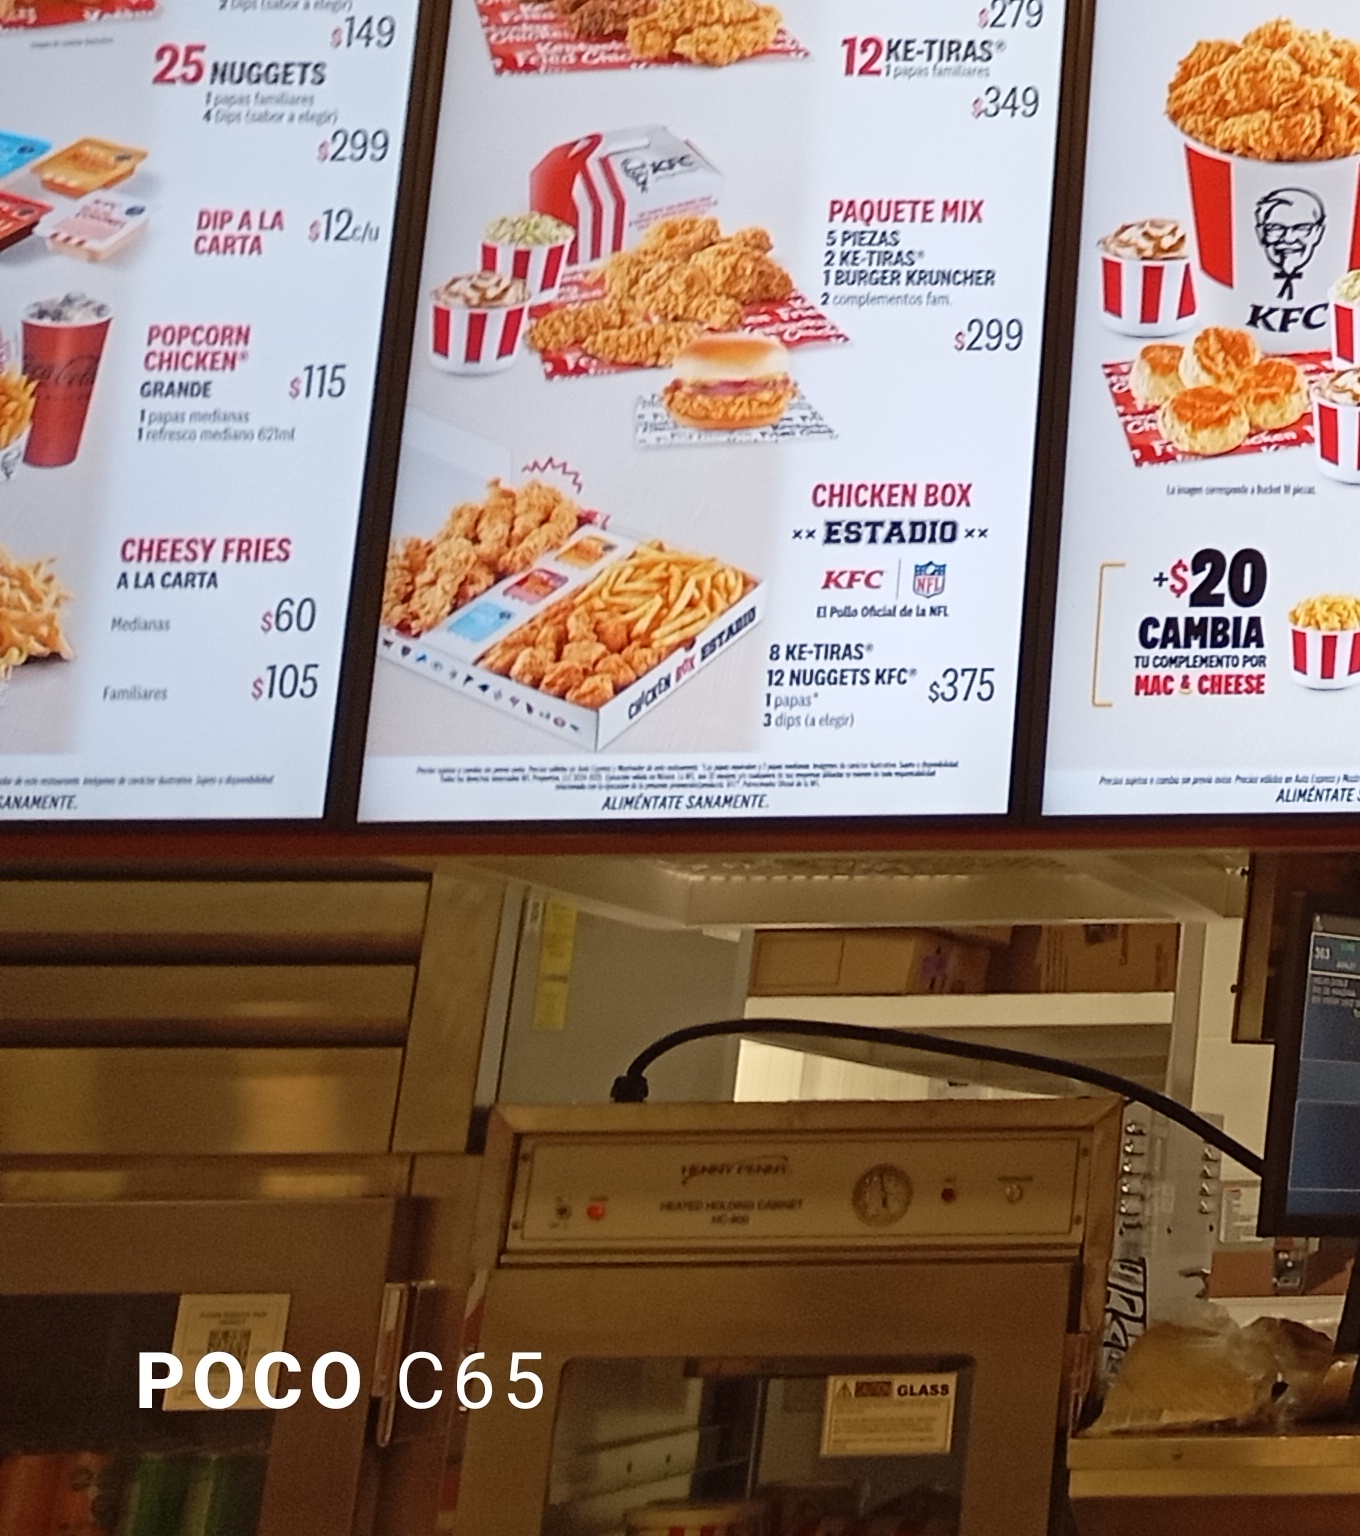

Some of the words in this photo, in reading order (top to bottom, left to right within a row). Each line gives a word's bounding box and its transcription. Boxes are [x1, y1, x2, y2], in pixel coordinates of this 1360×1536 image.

[330, 15, 396, 49] $149
[152, 43, 206, 86] 25
[210, 61, 327, 87] NUGGETS
[841, 37, 883, 77] 12
[972, 86, 1040, 119] $349
[317, 128, 390, 163] $299
[197, 210, 234, 231] DIP
[259, 210, 285, 231] LA
[828, 200, 935, 224] PAQUETE
[940, 200, 984, 223] MIX
[195, 235, 263, 255] CARTA
[841, 231, 900, 246] PIEZAS
[834, 270, 901, 286] BURGER
[905, 270, 996, 286] KRUNCHER
[1246, 304, 1329, 332] KFC
[147, 325, 250, 347] POPCORN
[954, 318, 1024, 351] $299
[140, 381, 211, 398] GRANDE
[288, 364, 347, 399] $115
[148, 411, 186, 429] papas
[189, 409, 249, 424] medianas
[811, 485, 917, 507] CHICKEN
[924, 483, 972, 506] BOX
[824, 521, 957, 544] ESTADIO
[121, 537, 214, 562] CHEESY
[222, 538, 292, 562] FRIES
[133, 573, 156, 589] LA
[160, 572, 218, 589] CARTA
[821, 570, 884, 589] KFC
[111, 616, 170, 632] Medianas
[260, 598, 316, 633] $60
[1138, 616, 1265, 650] CAMBIA
[251, 664, 319, 700] $105
[789, 668, 870, 686] NUGGETS
[928, 668, 996, 703] $375
[1134, 675, 1174, 696] MAC
[1198, 673, 1265, 695] CHEESE
[103, 686, 168, 702] Familiares
[1275, 786, 1353, 803] ALIMÉNTATE
[897, 1383, 950, 1397] GLASS
